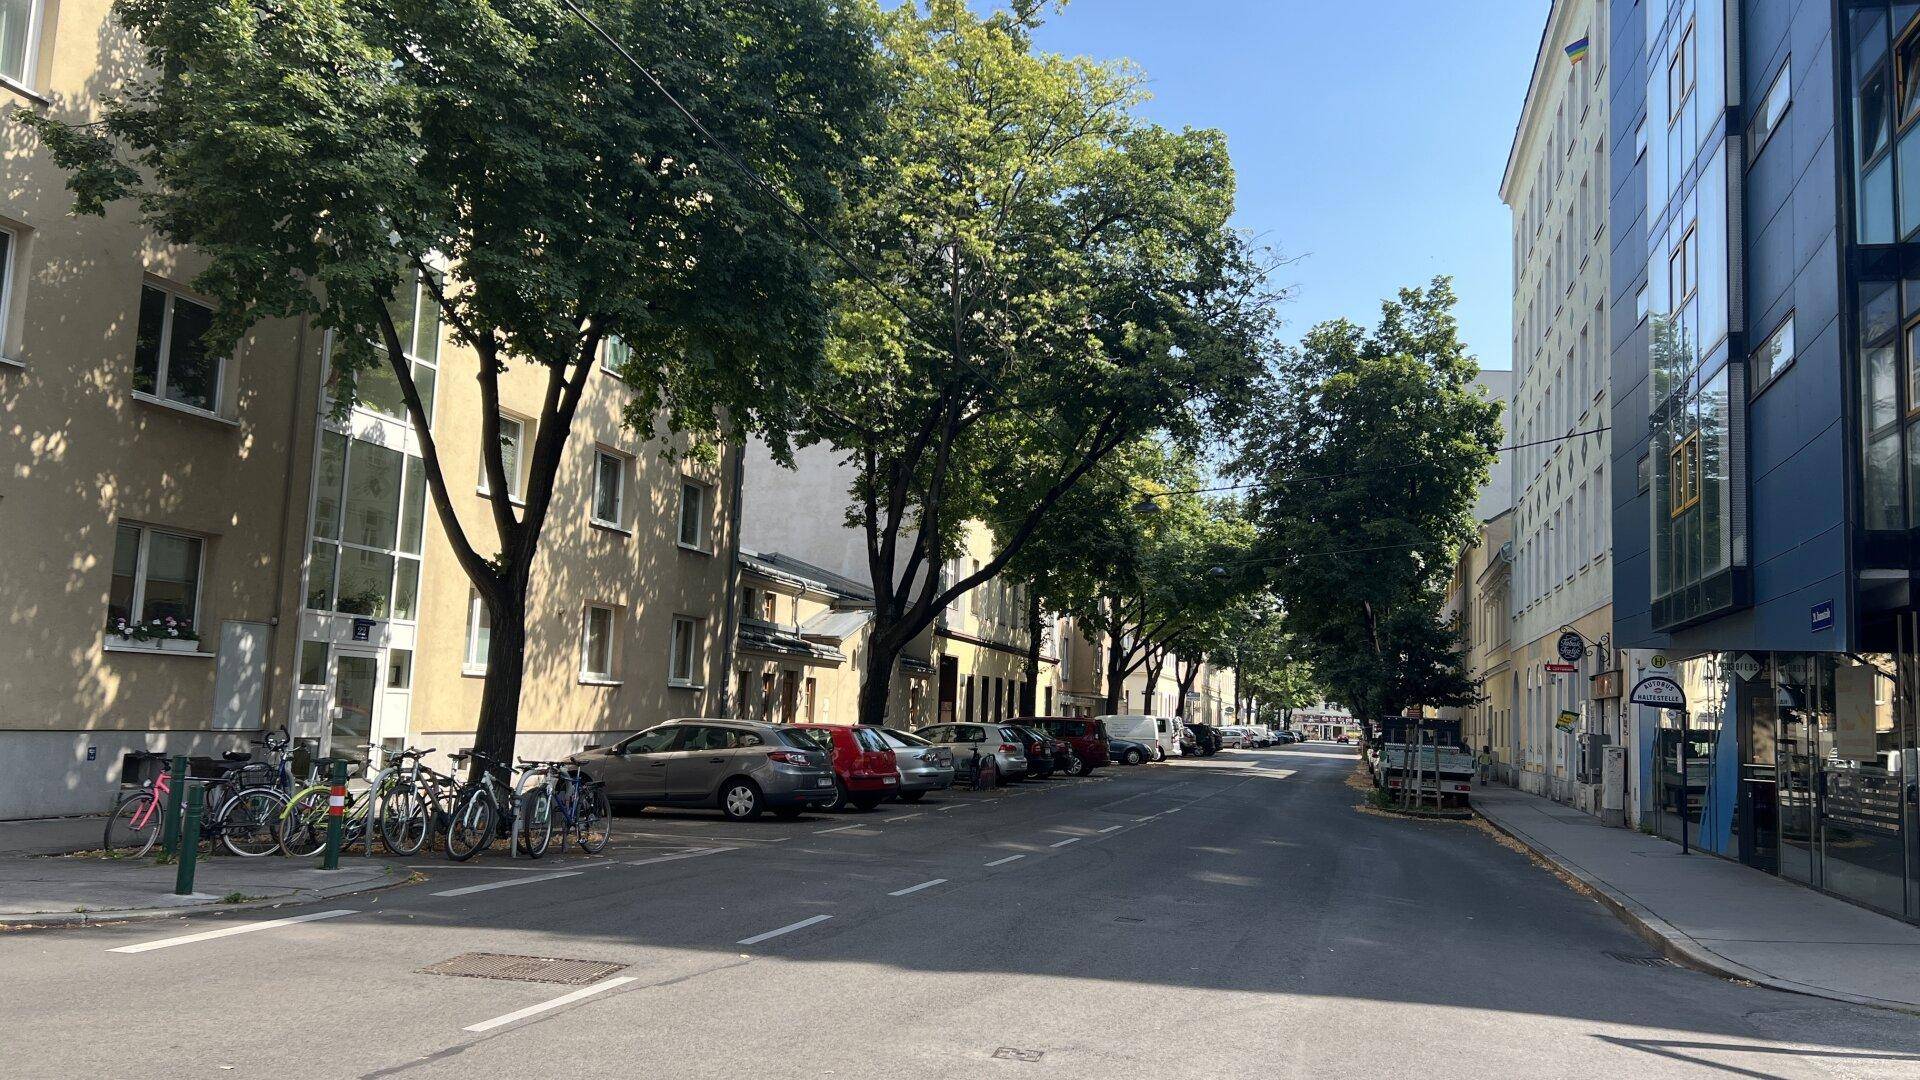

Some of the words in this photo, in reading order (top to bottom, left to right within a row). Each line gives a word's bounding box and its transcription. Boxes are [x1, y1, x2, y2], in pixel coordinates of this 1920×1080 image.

[1654, 657, 1663, 666] H
[1643, 681, 1675, 692] AUTOBUS
[1637, 694, 1679, 702] HALTESTELLE
